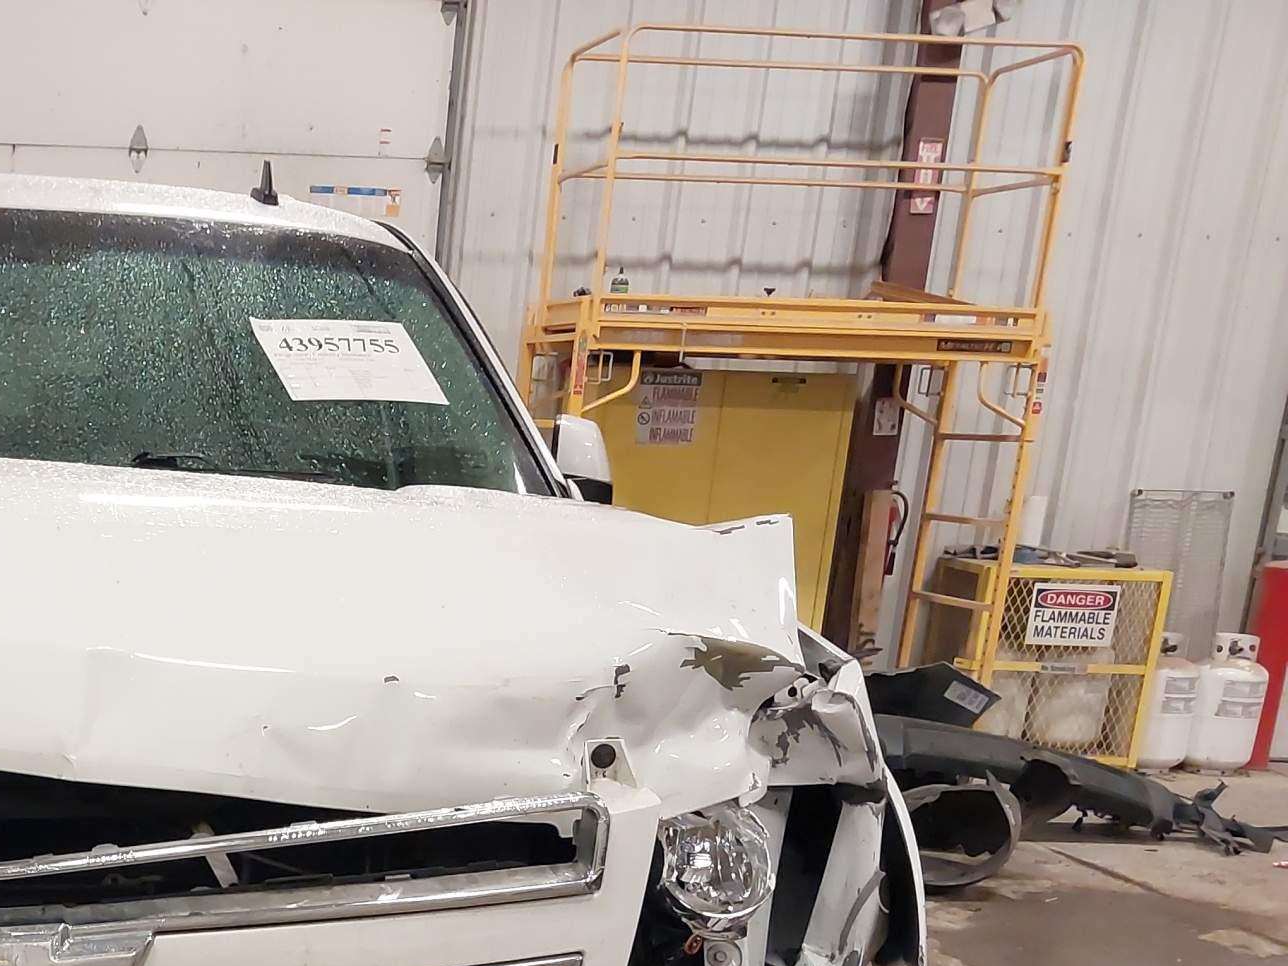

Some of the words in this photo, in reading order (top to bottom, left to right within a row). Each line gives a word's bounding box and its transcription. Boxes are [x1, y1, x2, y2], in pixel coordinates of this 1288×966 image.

[279, 336, 400, 354] 43957755
[655, 373, 699, 385] Justrite
[1047, 593, 1105, 606] DANGER
[1034, 610, 1111, 625] FLAMMABLE
[1033, 626, 1106, 640] MATERIALS
